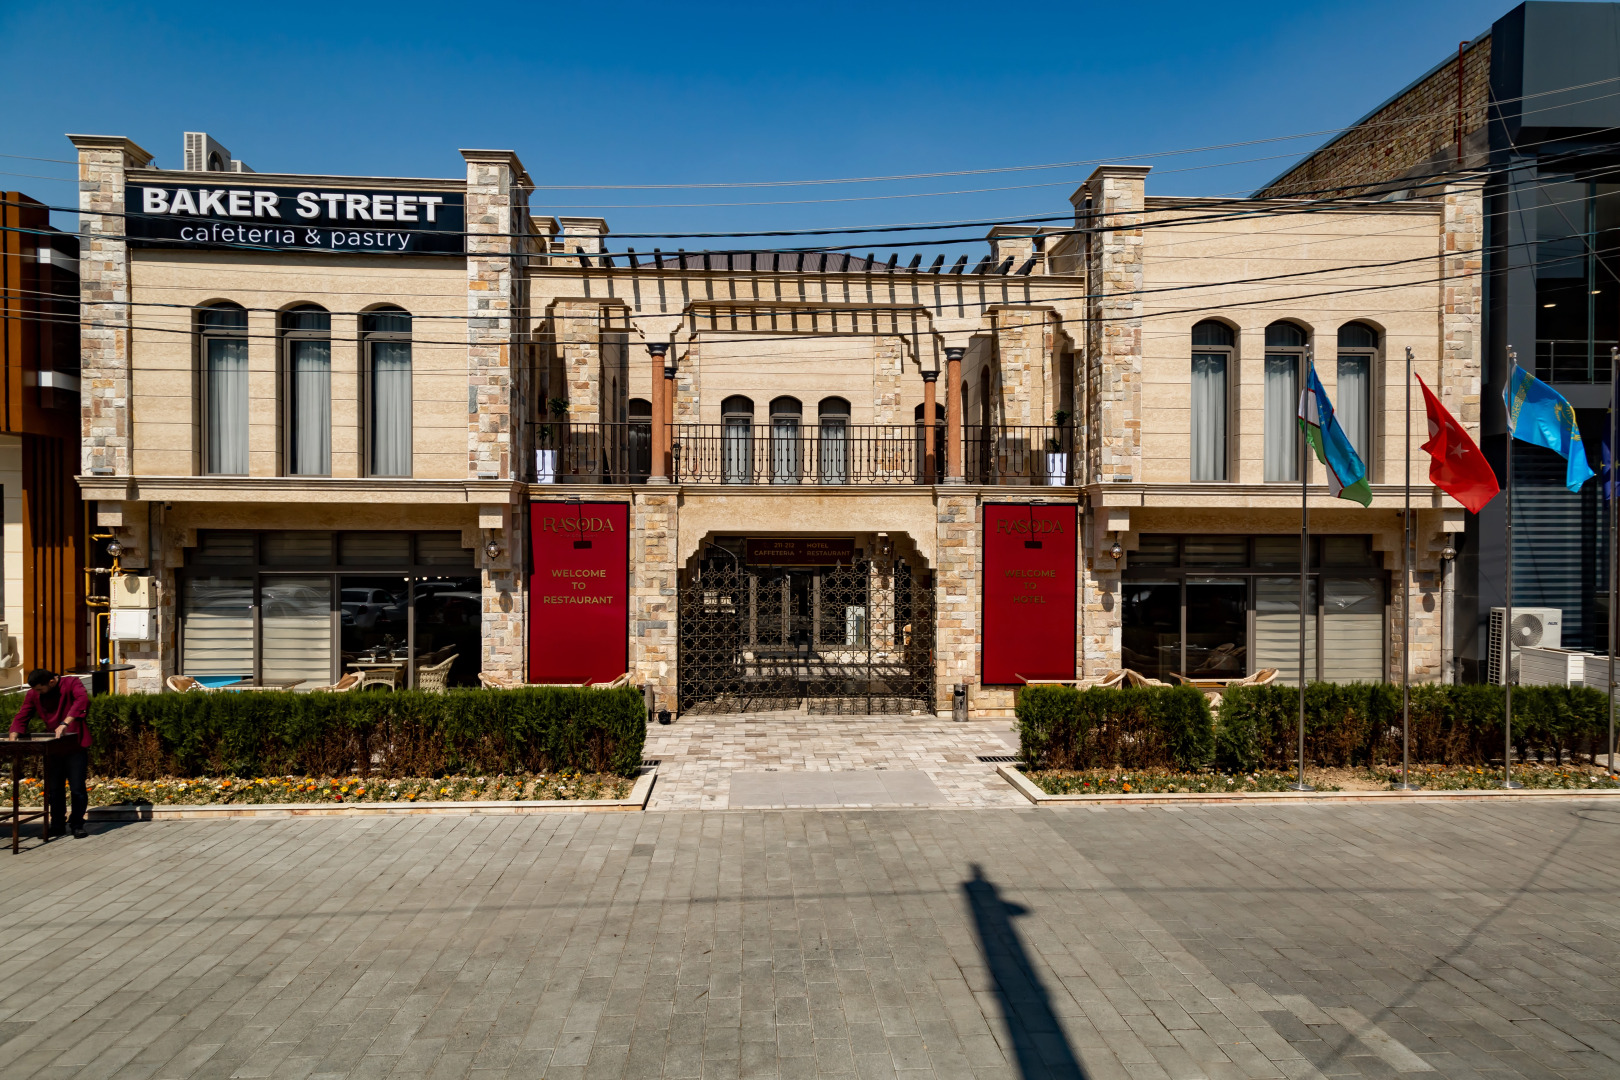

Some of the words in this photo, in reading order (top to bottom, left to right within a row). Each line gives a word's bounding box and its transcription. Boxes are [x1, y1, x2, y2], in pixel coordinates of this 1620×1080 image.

[143, 187, 281, 218] BAKER
[295, 191, 443, 223] STREET
[180, 223, 295, 244] cafeteria
[305, 228, 321, 245] &
[331, 230, 411, 250] pastry
[543, 517, 615, 533] RASODA
[996, 519, 1064, 535] RASODA
[551, 569, 607, 578] WELCOME
[1004, 569, 1056, 578] WELCOME
[571, 581, 586, 590] TO
[1023, 582, 1037, 590] TO
[543, 595, 613, 604] RESTAURANT
[1013, 595, 1046, 604] HOTEL
